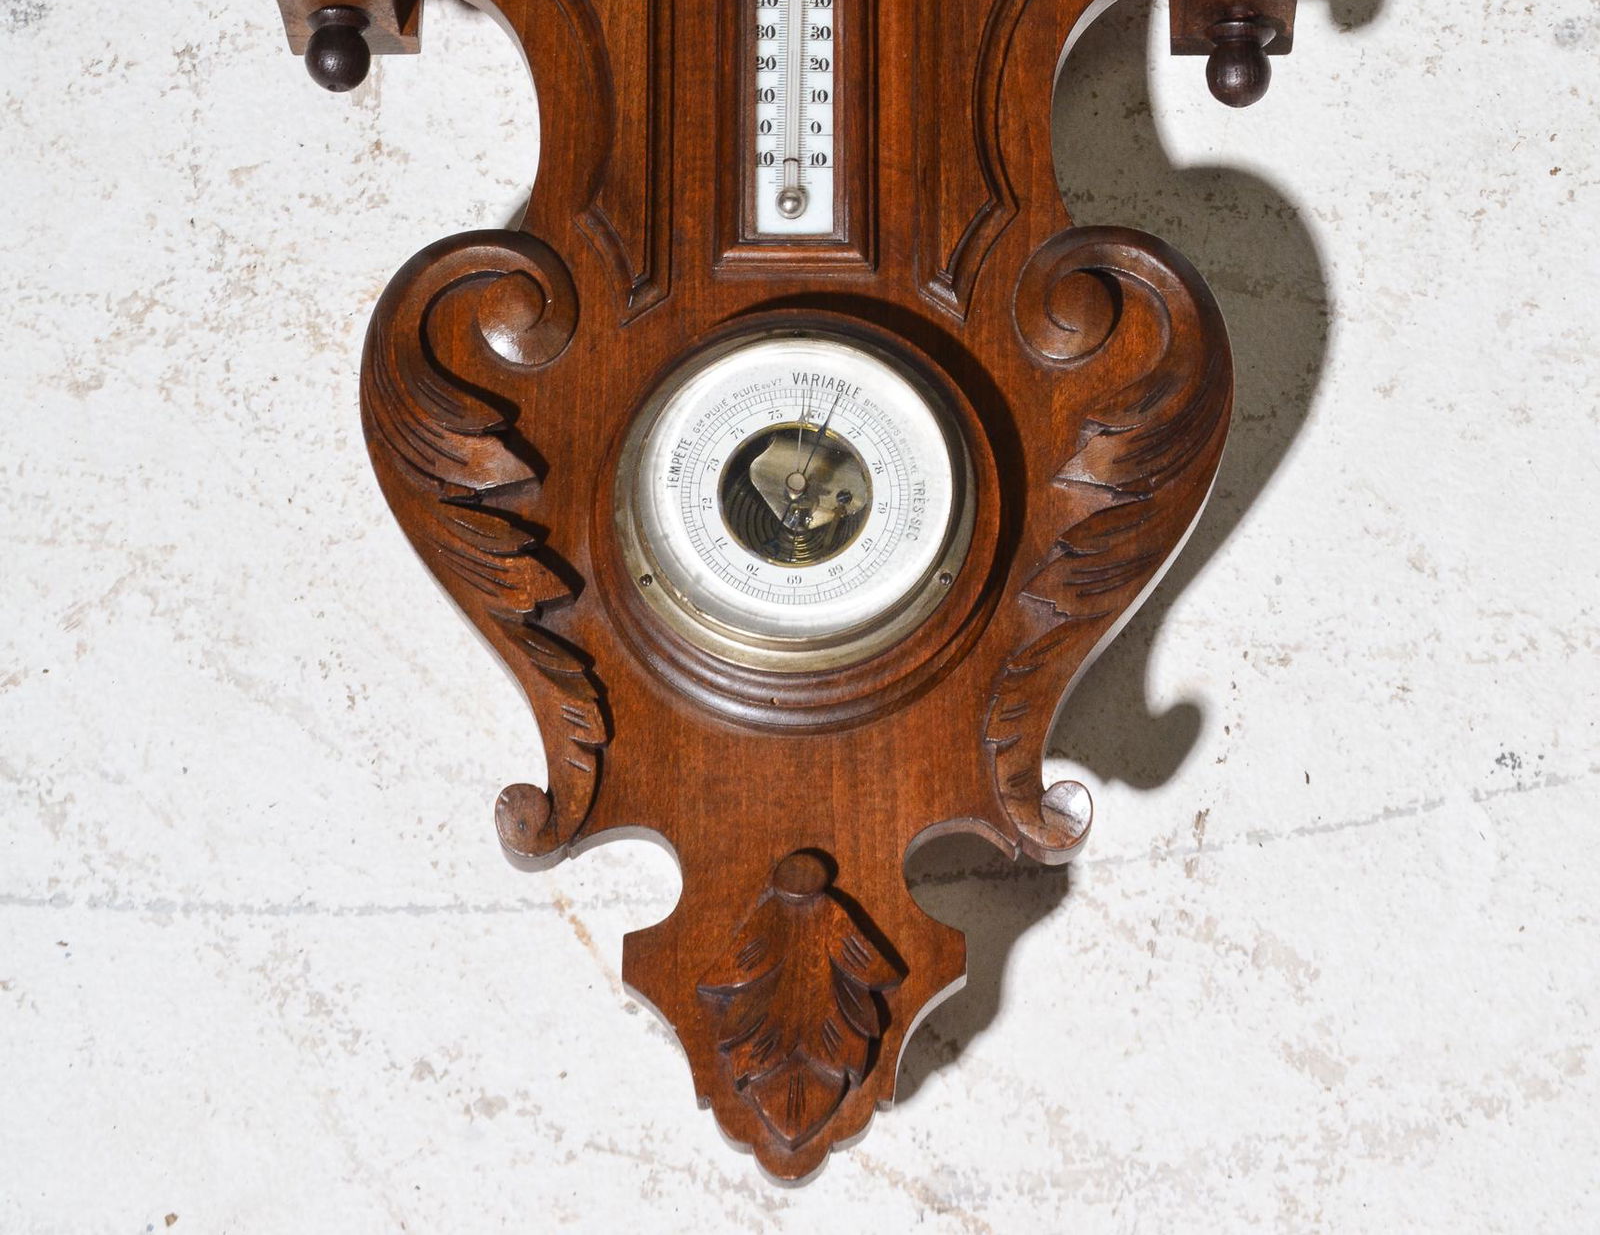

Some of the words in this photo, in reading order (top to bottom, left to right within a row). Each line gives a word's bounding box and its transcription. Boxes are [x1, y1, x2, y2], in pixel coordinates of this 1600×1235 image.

[811, 25, 832, 40] 30
[756, 56, 777, 71] 20
[809, 57, 830, 71] 20
[757, 88, 776, 103] 10
[811, 89, 828, 103] 10
[760, 119, 772, 135] 0
[810, 120, 822, 135] 0
[810, 152, 827, 166] 10
[733, 383, 760, 400] PLUIE
[792, 372, 862, 399] VARIABLE
[705, 399, 729, 420] PLUIE
[768, 409, 783, 420] 75
[730, 427, 745, 440] 74
[666, 437, 692, 488] TEMPÊTE
[707, 458, 720, 472] 73
[872, 460, 884, 475] 78
[702, 497, 712, 511] 72
[878, 501, 888, 514] 79
[715, 536, 729, 551] 71
[746, 563, 760, 577] 70
[787, 575, 803, 585] 69
